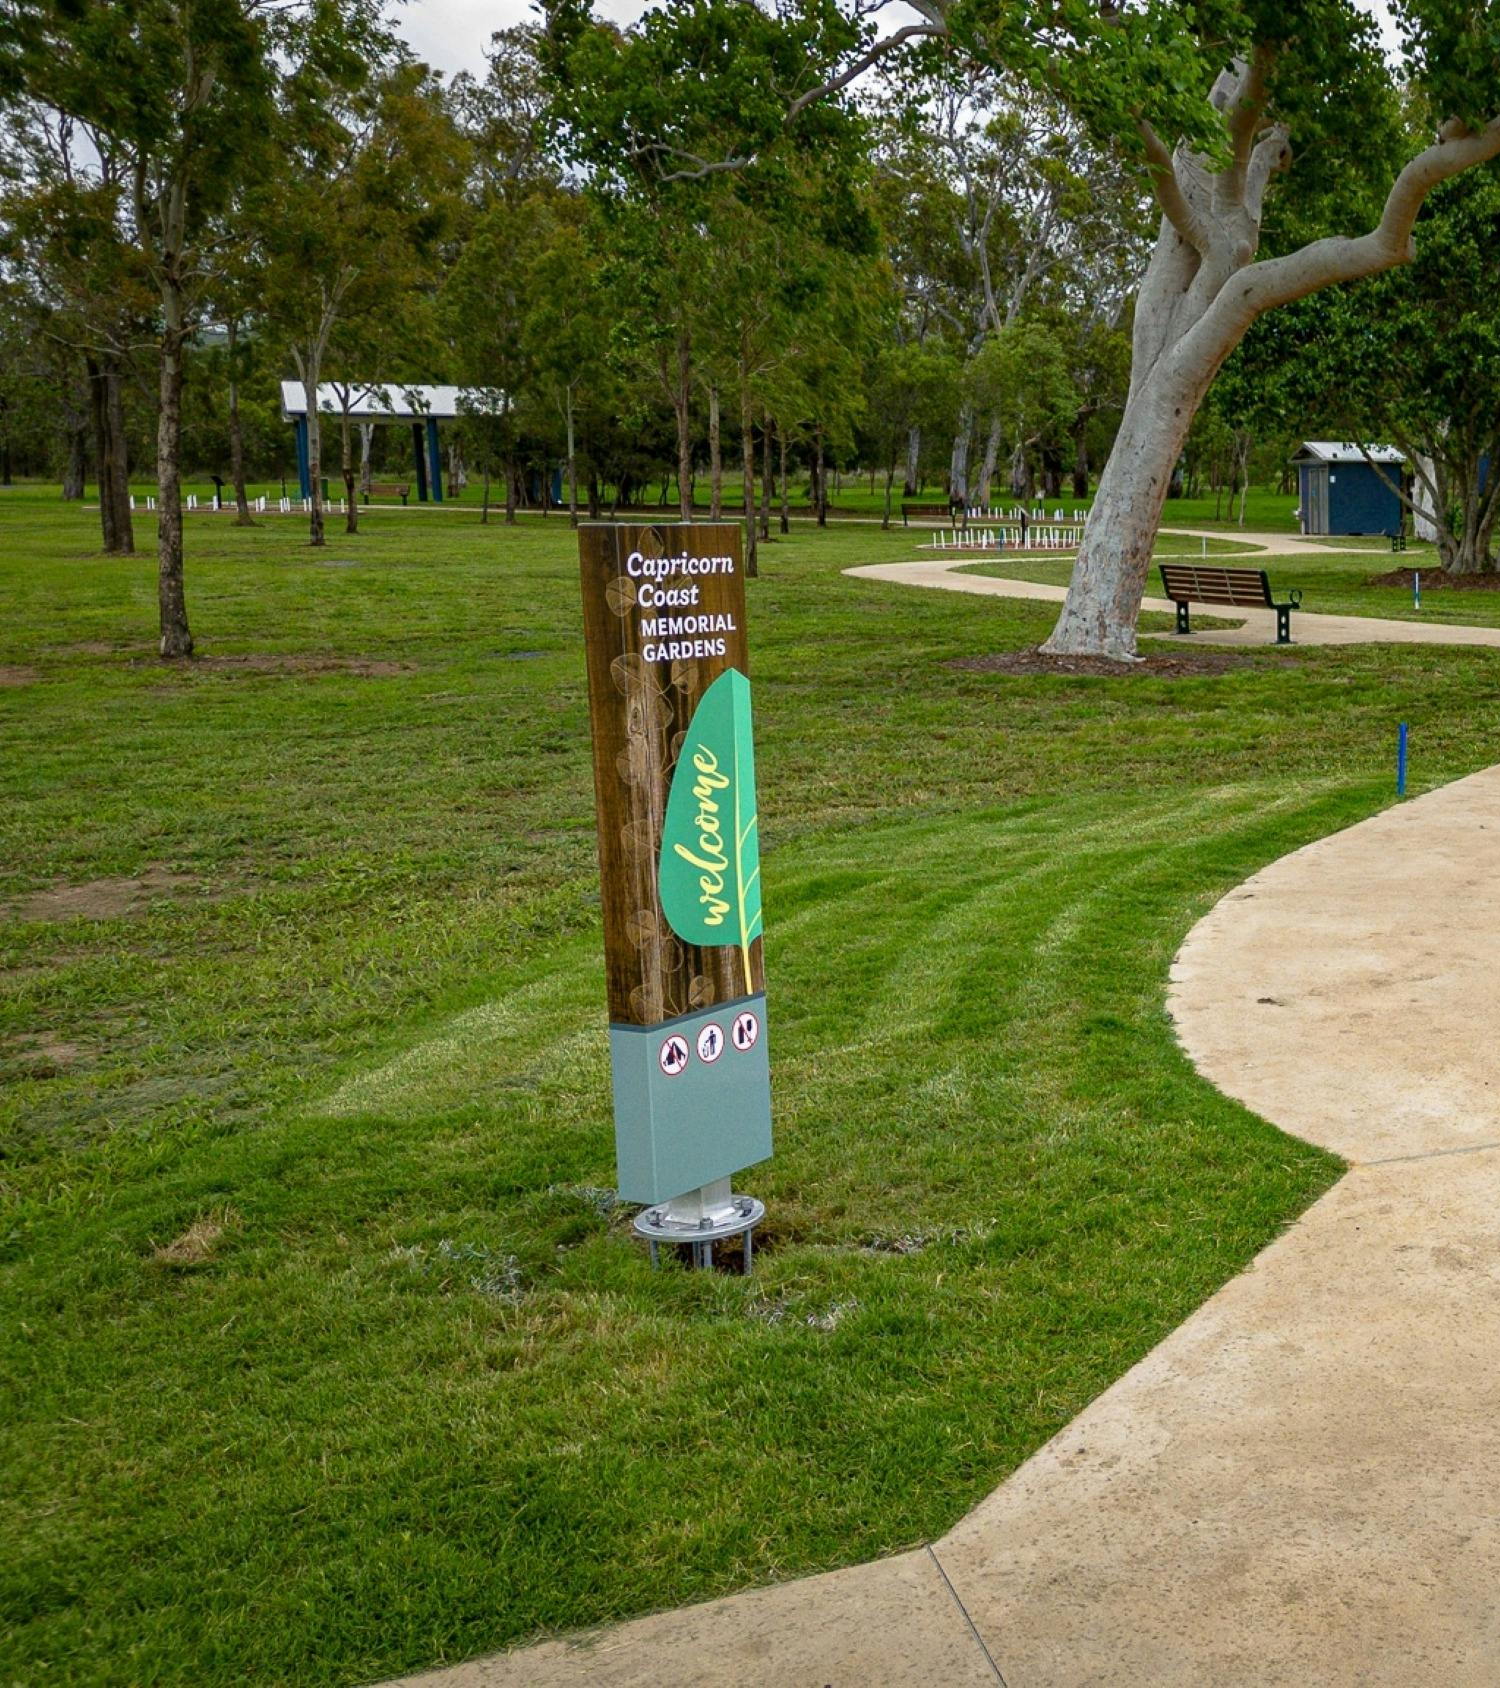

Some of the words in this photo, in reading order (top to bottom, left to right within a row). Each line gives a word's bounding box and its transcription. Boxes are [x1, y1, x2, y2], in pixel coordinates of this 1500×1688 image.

[627, 551, 734, 582] Capricorn
[637, 583, 699, 607] Coast
[641, 613, 736, 636] MEMORIAL
[643, 638, 726, 662] GARDENS
[674, 743, 731, 927] welcome
